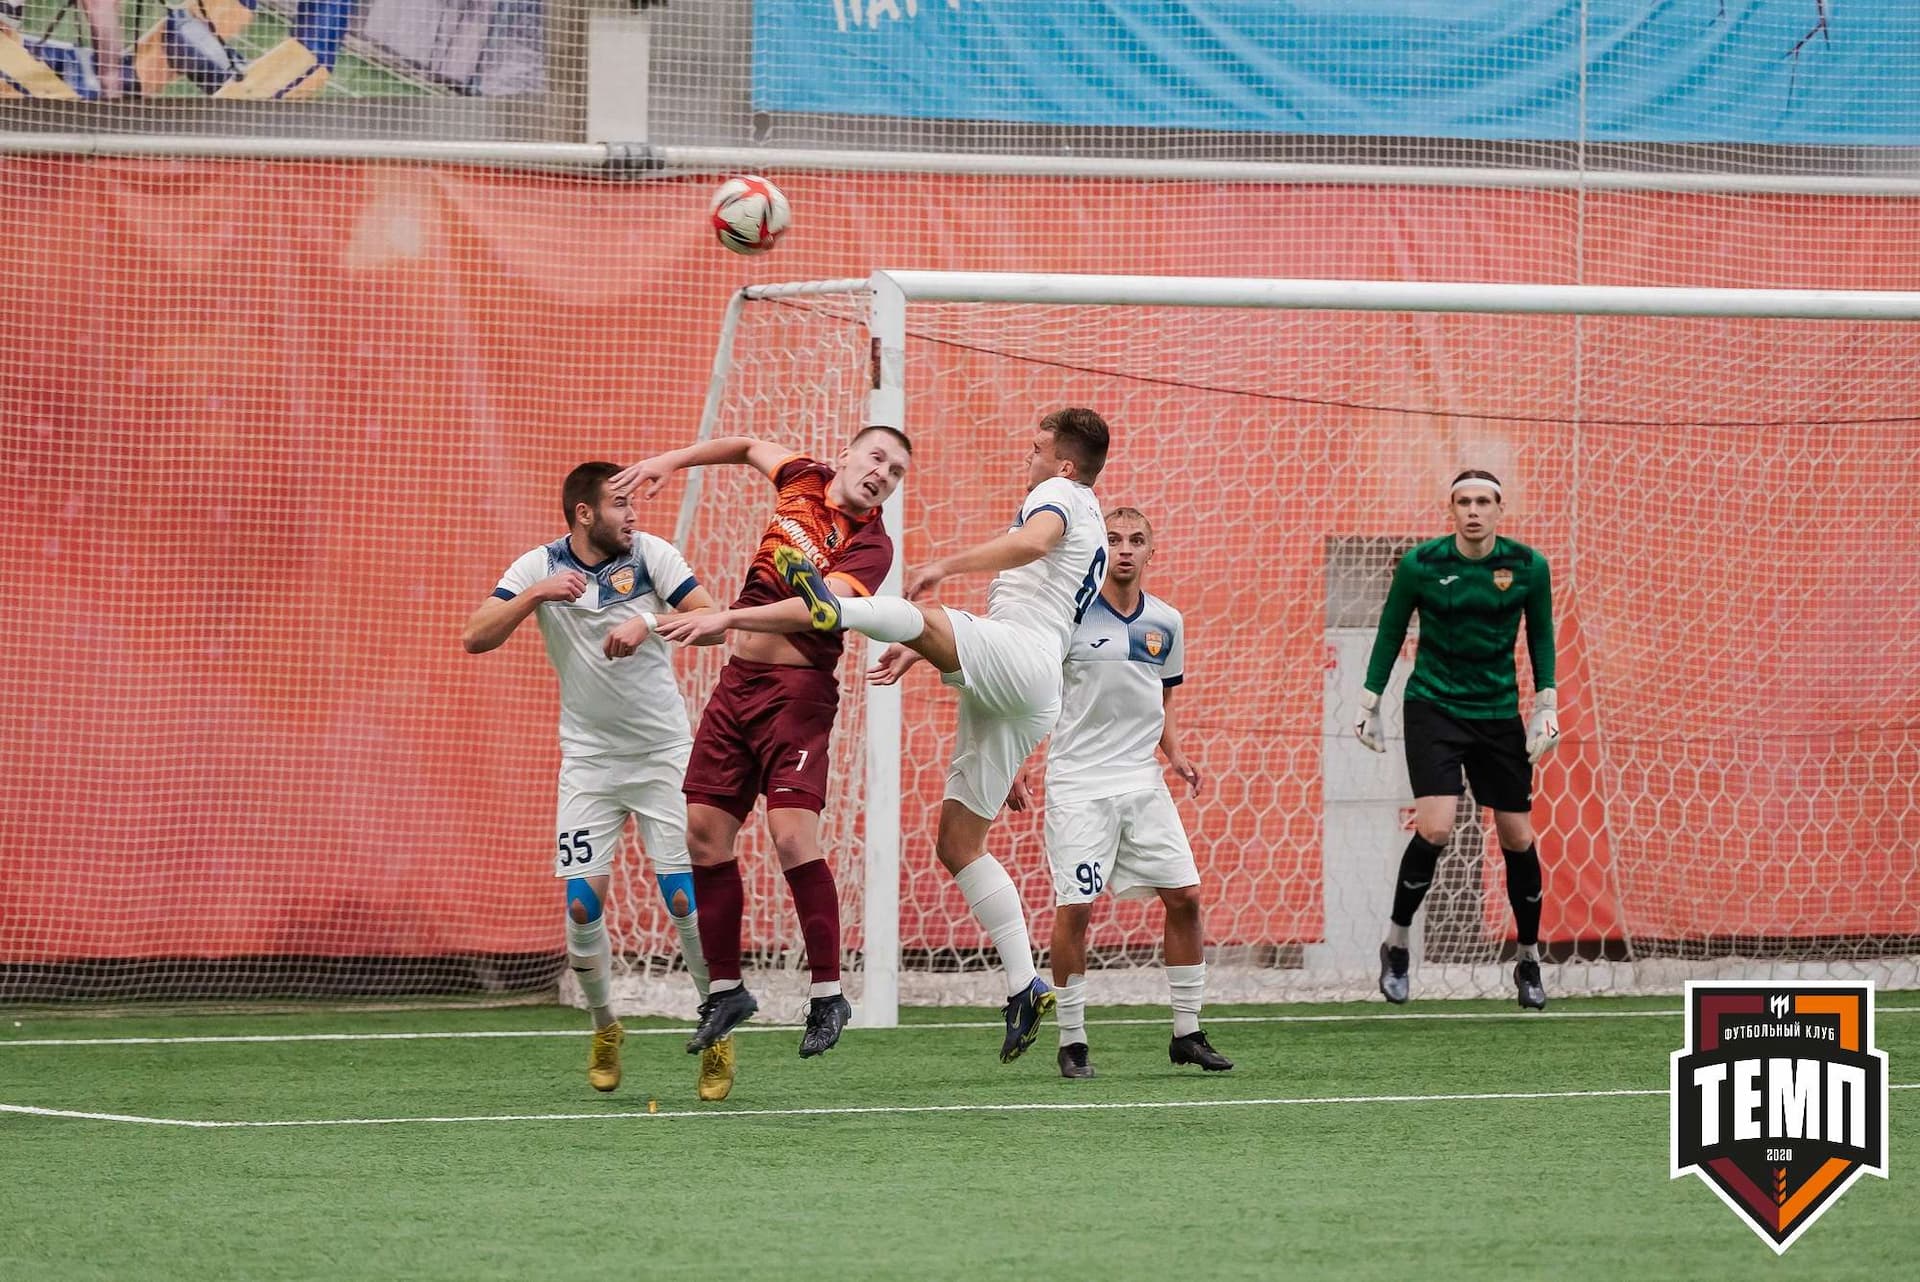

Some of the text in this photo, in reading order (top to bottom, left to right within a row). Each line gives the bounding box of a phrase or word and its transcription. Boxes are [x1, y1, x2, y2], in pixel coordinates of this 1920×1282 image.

[796, 749, 809, 772] 7
[558, 829, 593, 867] 55
[1075, 861, 1103, 896] 96
